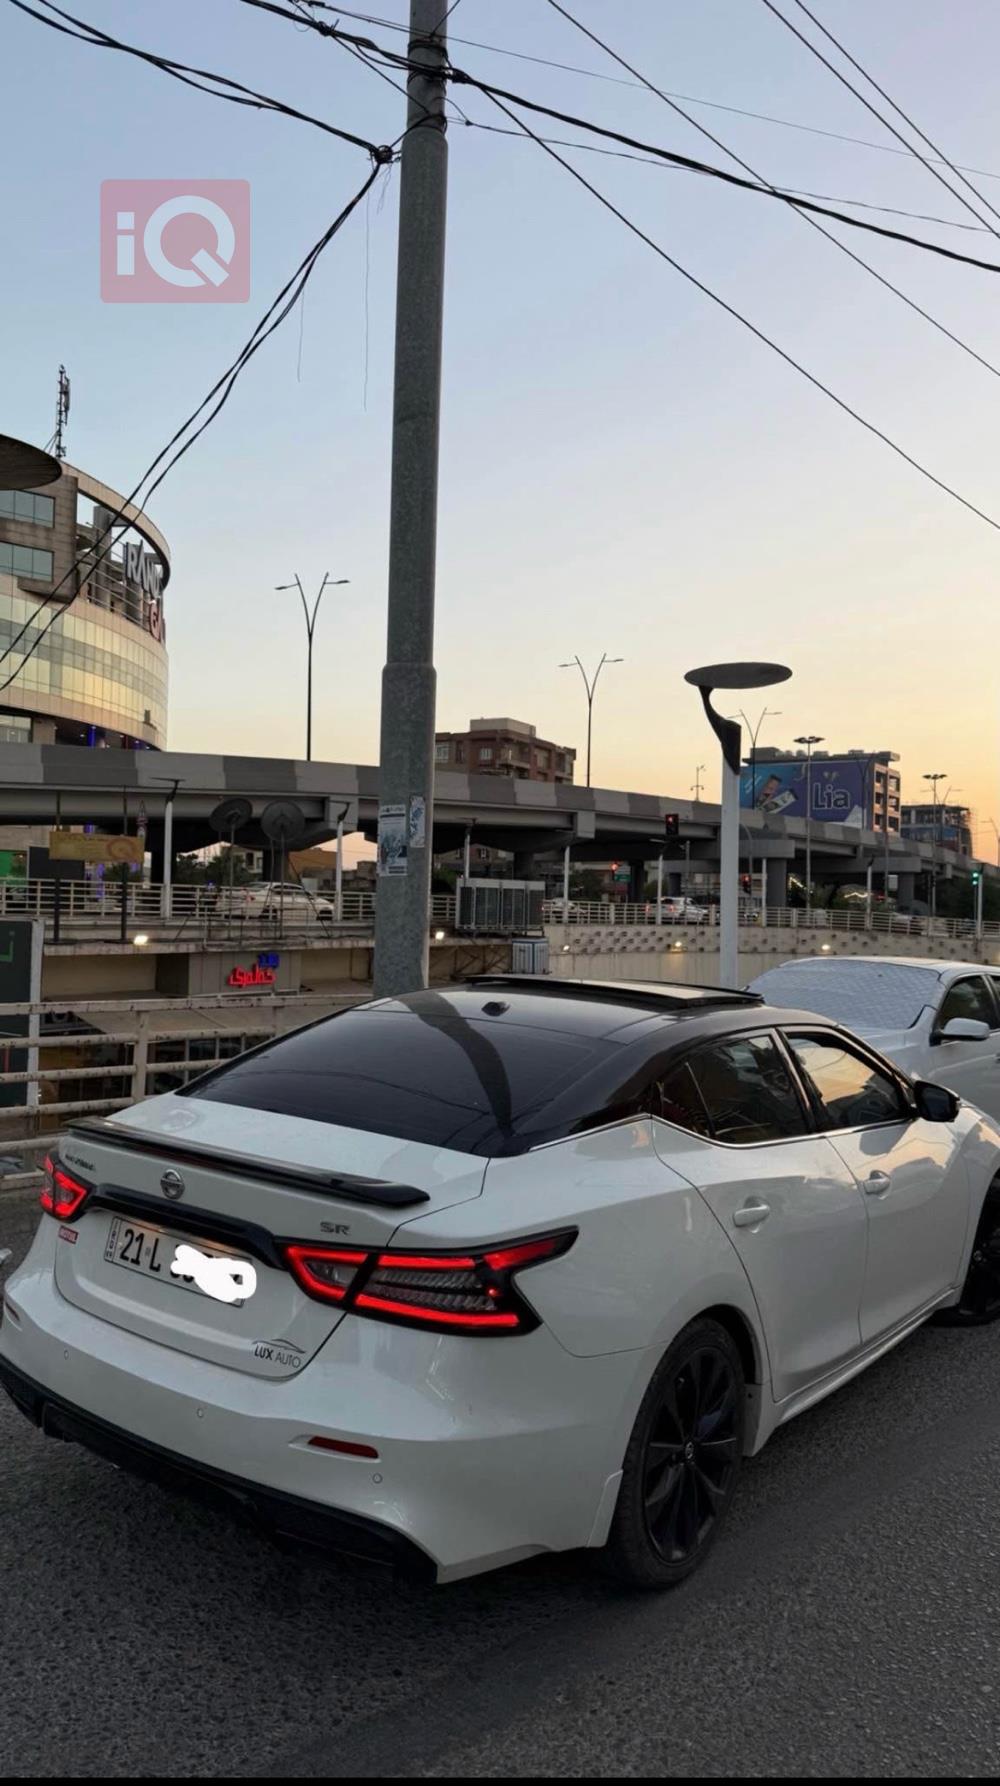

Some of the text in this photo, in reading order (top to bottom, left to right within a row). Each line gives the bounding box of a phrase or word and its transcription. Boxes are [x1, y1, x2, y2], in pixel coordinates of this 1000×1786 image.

[812, 782, 850, 810] Lia
[320, 1221, 350, 1235] SR
[120, 1228, 144, 1266] 21
[150, 1237, 161, 1272] L
[254, 1344, 301, 1369] LUX AUTO
